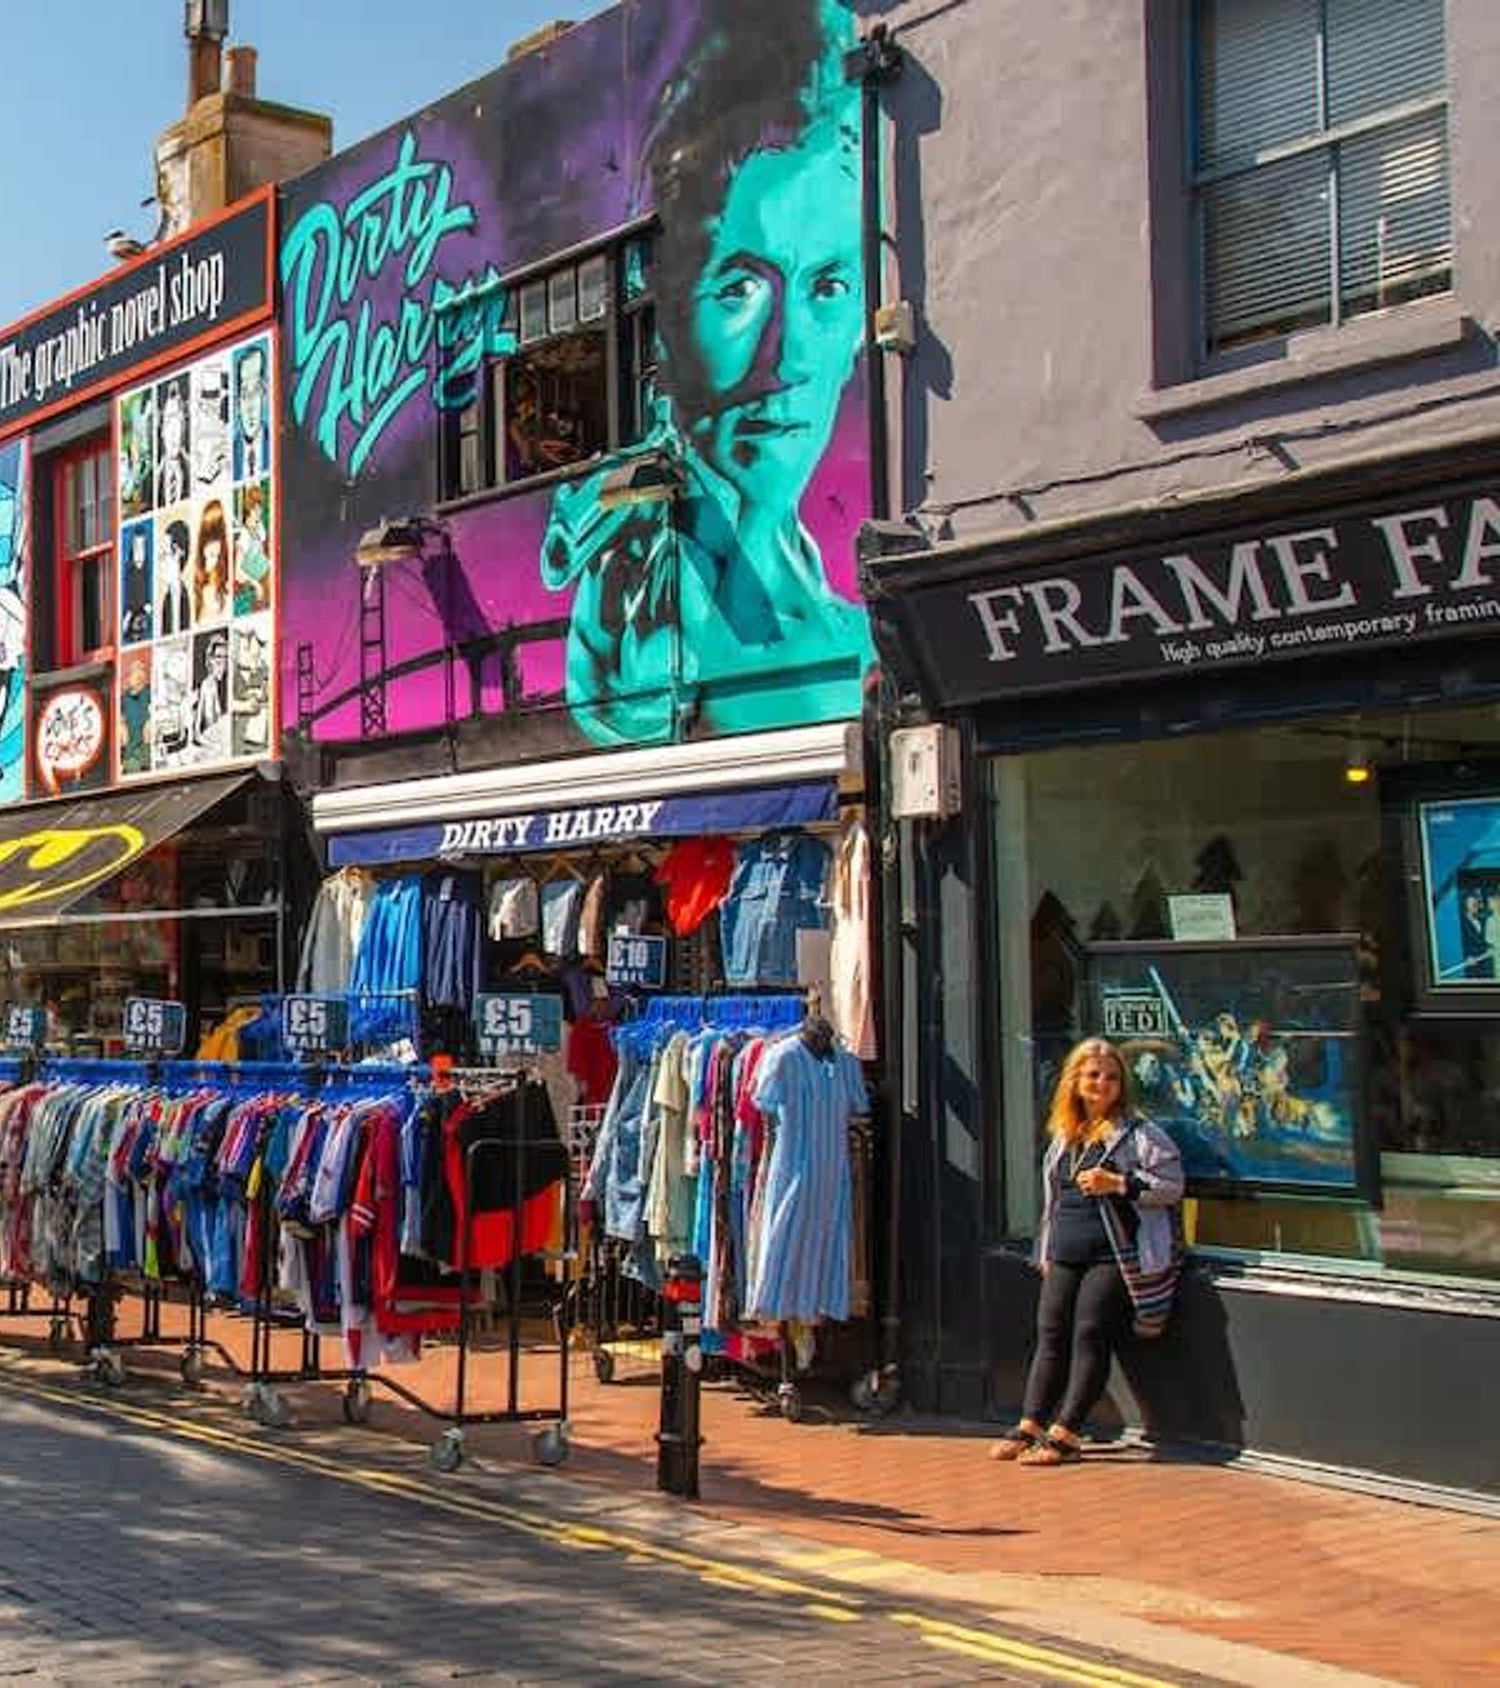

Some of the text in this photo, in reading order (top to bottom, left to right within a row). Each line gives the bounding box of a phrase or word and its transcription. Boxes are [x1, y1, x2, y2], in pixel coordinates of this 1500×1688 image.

[280, 129, 476, 371] Dirty
[34, 301, 107, 400] graphic
[111, 265, 165, 356] novel
[169, 252, 224, 321] shop
[293, 266, 518, 478] Harry
[968, 528, 1357, 662] FRAME
[1160, 640, 1201, 665] High
[1205, 631, 1265, 660] quality
[1269, 610, 1417, 652] contemporary
[440, 801, 664, 852] DIRTY HARRY
[612, 940, 648, 968] £10
[10, 1006, 33, 1036] £5
[130, 1000, 164, 1037] £5
[290, 999, 326, 1034] £5
[484, 998, 533, 1036] £5
